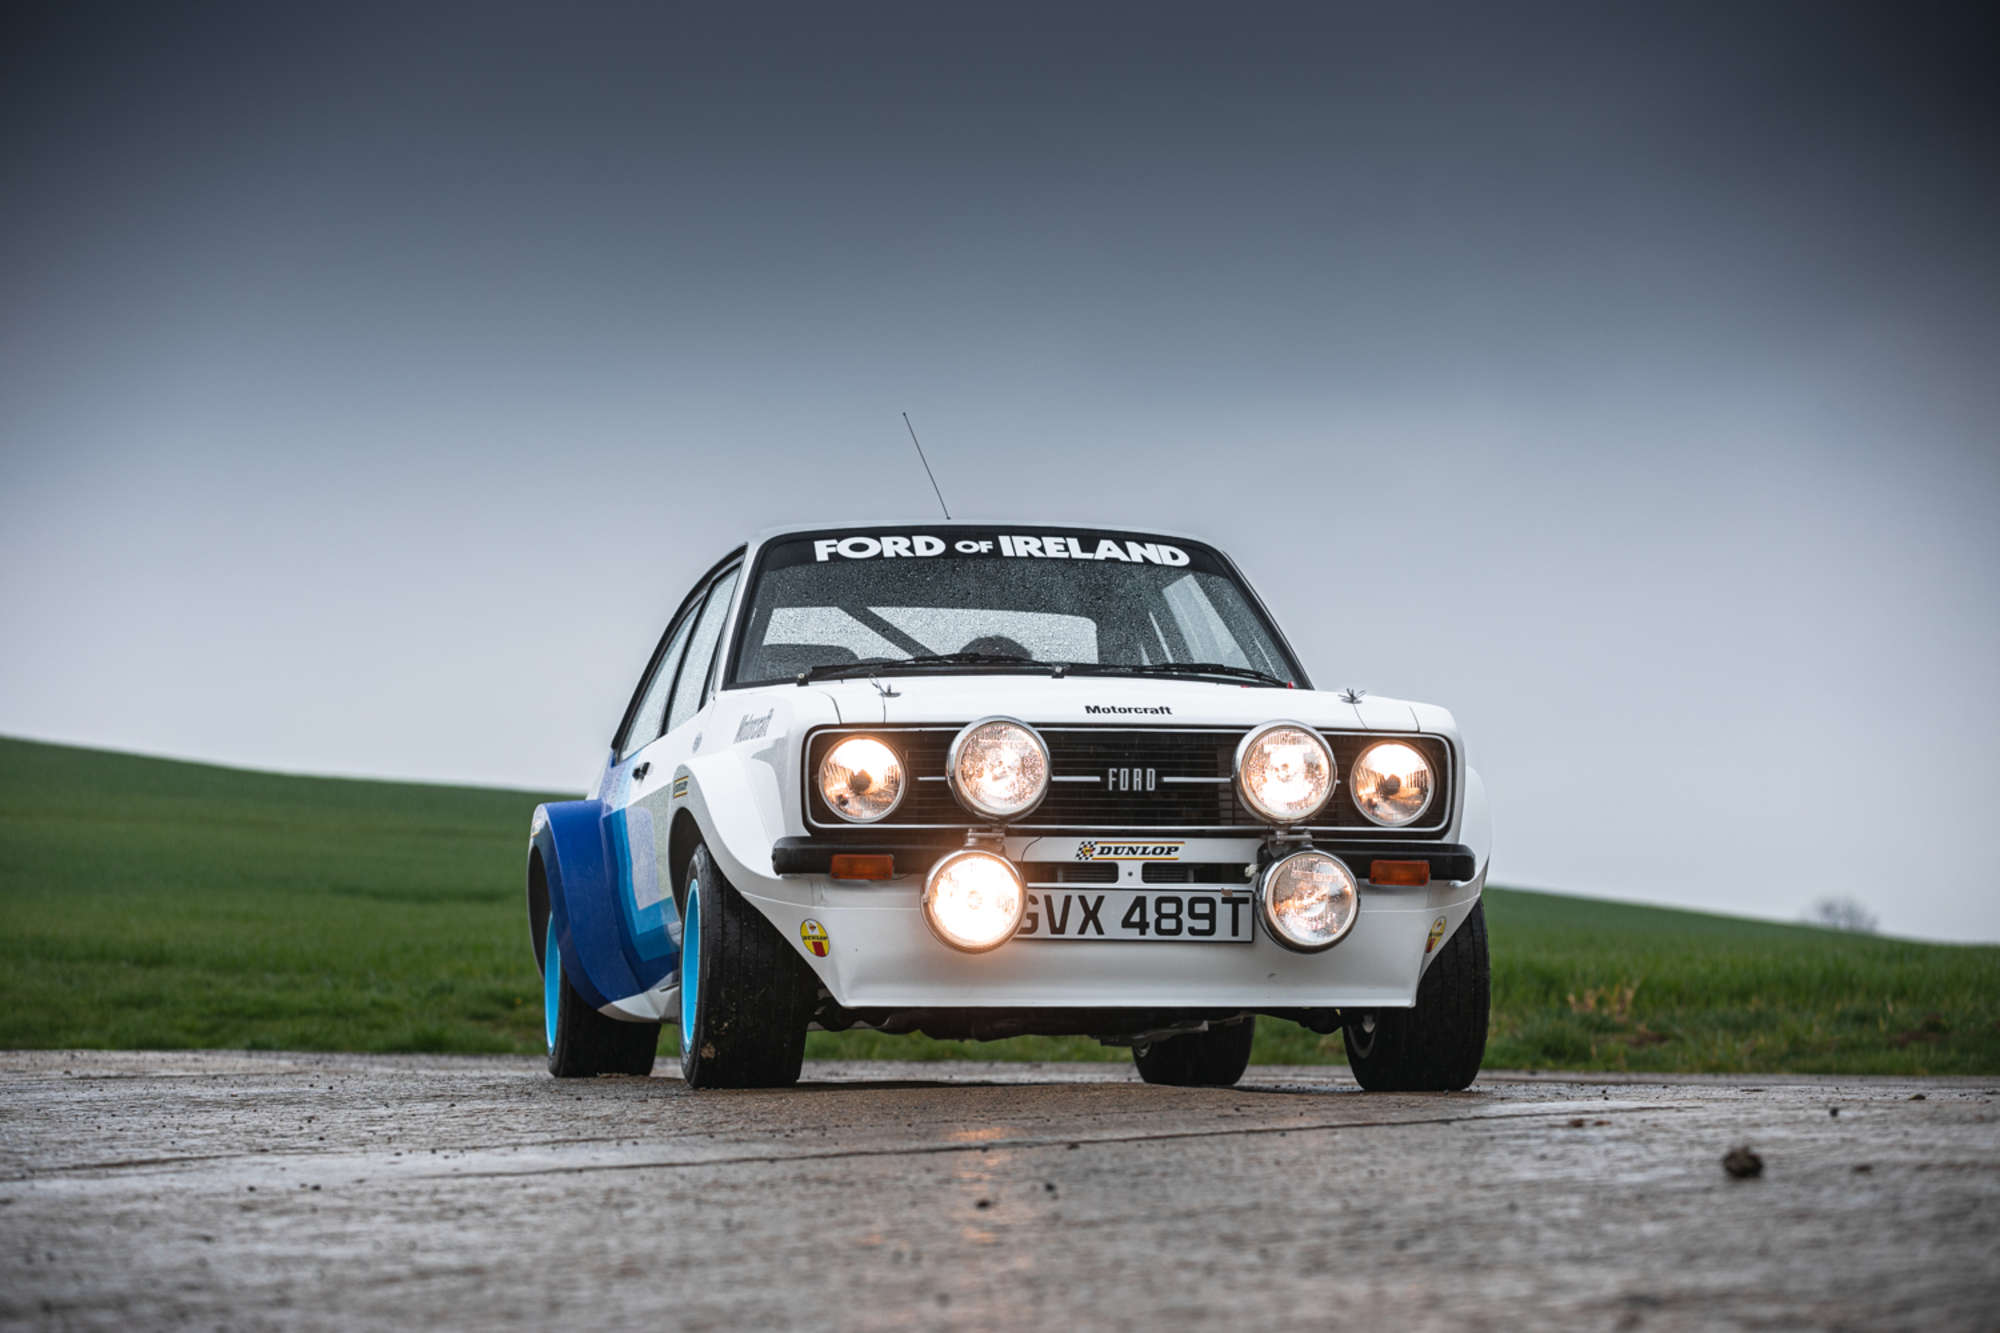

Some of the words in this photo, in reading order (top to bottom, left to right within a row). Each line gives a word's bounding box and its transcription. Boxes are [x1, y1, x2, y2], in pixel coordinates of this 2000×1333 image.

[814, 535, 946, 562] FORD
[954, 540, 993, 553] OF
[998, 535, 1190, 567] IRELAND
[1084, 705, 1173, 715] Motorcraft
[1108, 768, 1156, 791] FORD
[1097, 846, 1180, 855] DUNLOP
[1121, 895, 1250, 937] 489T
